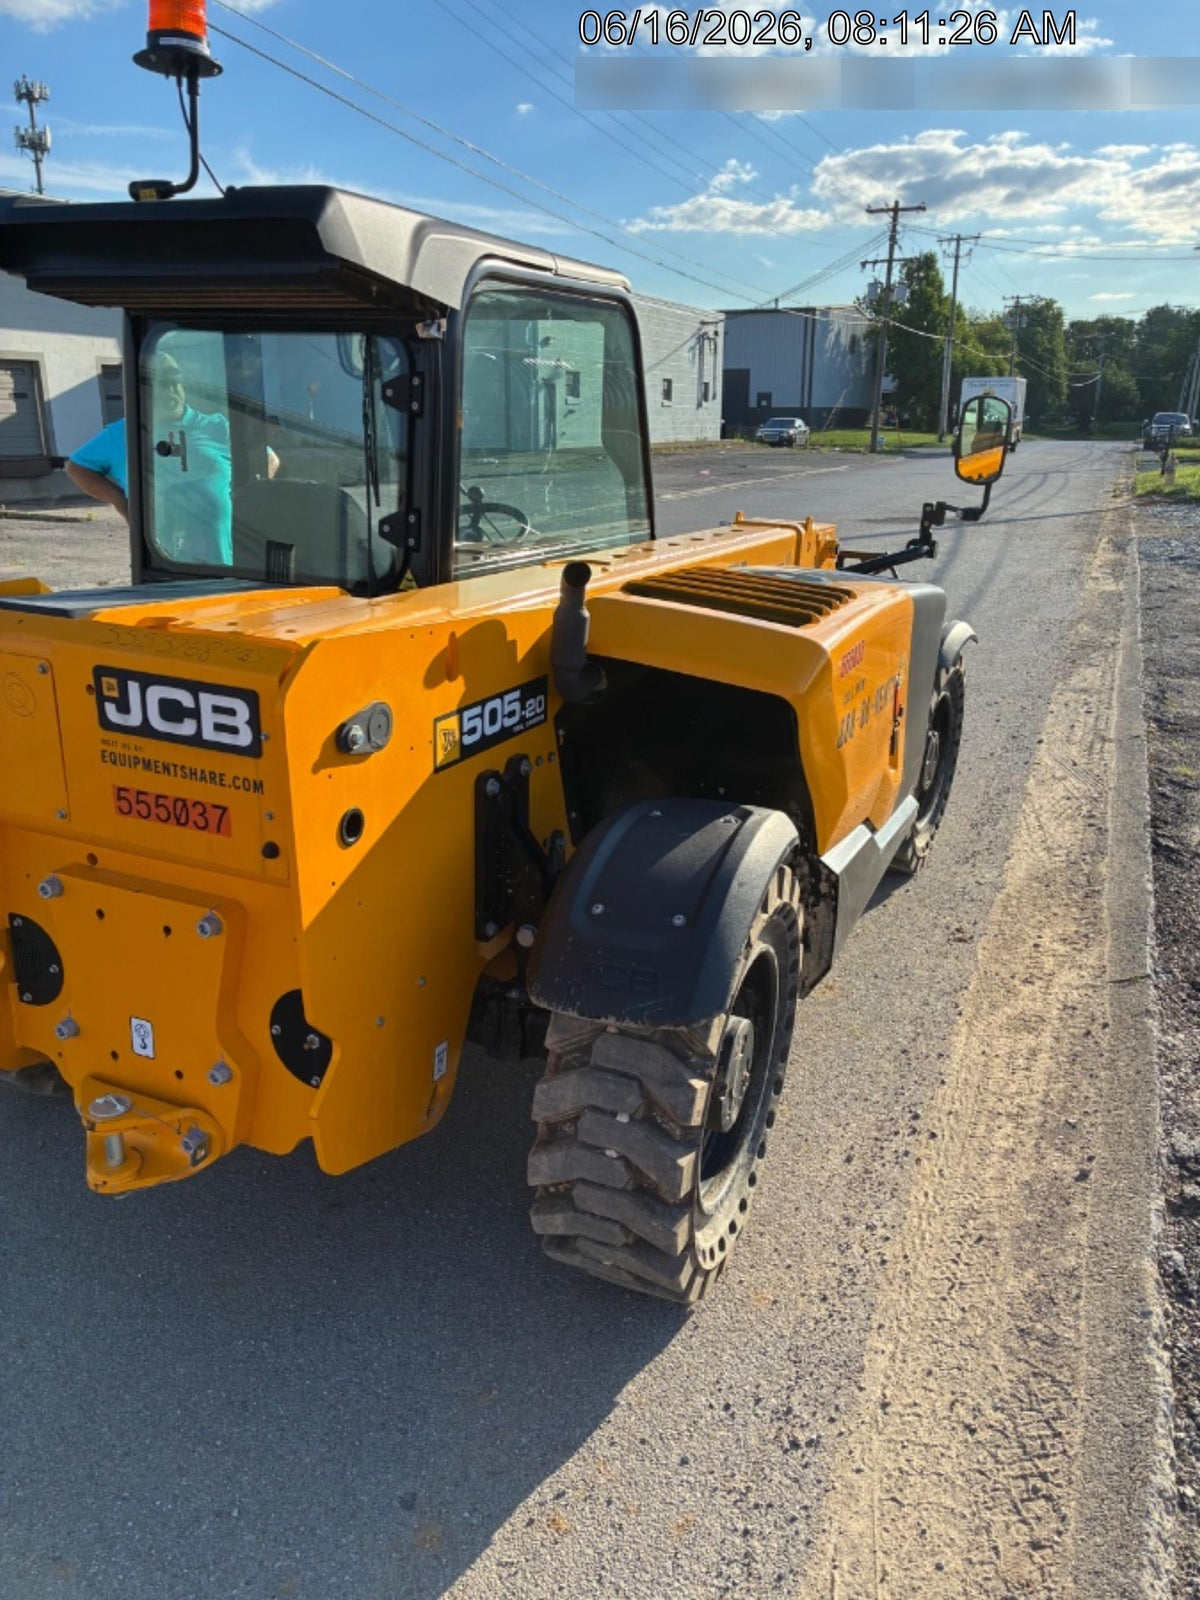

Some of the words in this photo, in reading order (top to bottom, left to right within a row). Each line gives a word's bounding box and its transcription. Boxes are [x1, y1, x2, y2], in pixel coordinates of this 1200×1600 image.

[104, 680, 253, 747] JCB
[101, 750, 264, 795] EQUIPMENTSHARE.COM
[116, 787, 228, 834] 555037
